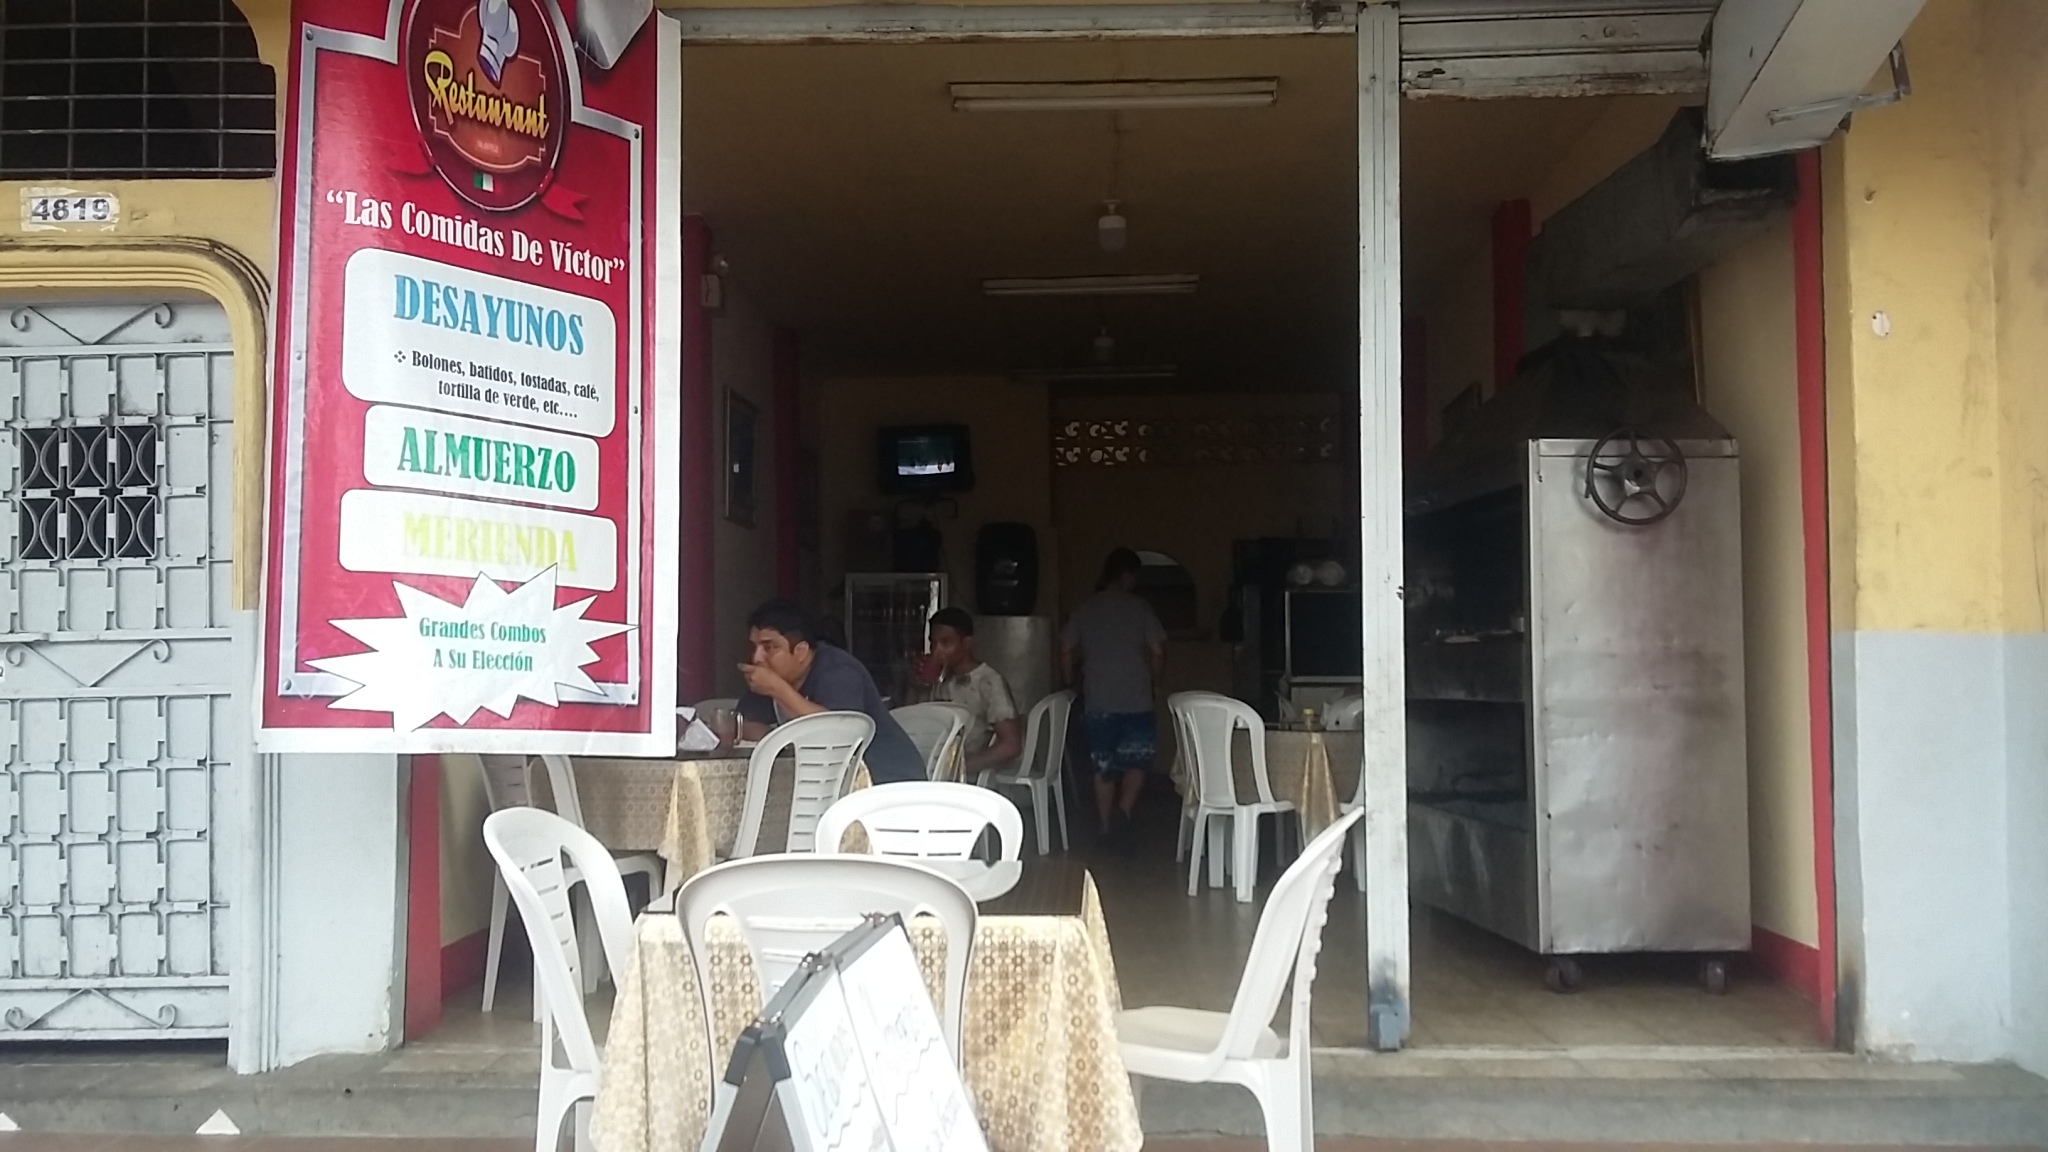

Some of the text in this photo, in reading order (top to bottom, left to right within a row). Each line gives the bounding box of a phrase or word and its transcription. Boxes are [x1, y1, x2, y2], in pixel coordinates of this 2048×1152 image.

[424, 50, 549, 138] Restaurant
[31, 198, 110, 221] 4819
[401, 201, 505, 257] Comidas
[511, 230, 543, 266] De
[393, 274, 584, 355] DESAYUNOS
[412, 350, 600, 402] Bolones, batidos, tostadas, café,
[438, 379, 481, 402] tortilla
[484, 388, 499, 404] de
[503, 393, 539, 413] verde,
[397, 426, 576, 493] ALMUERZO
[402, 511, 577, 572] MERIENDA
[419, 617, 546, 644] Grandes Combos
[433, 648, 533, 672] A Su Elección
